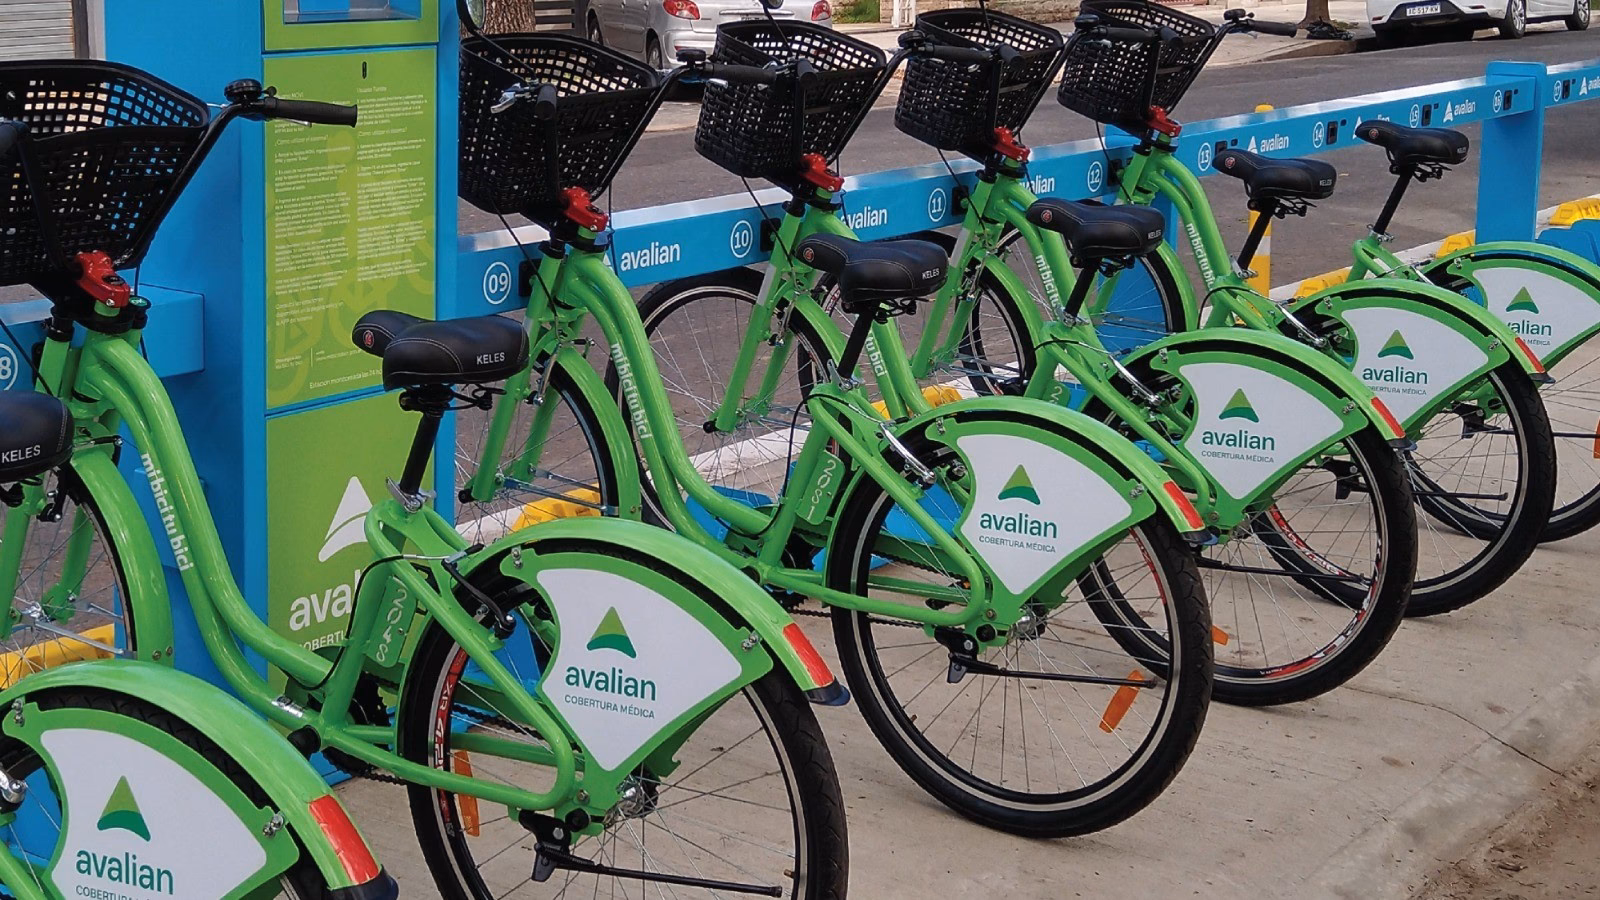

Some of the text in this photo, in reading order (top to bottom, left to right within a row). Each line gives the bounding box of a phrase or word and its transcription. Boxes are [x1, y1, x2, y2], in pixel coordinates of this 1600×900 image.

[1454, 100, 1476, 116] avalian
[1260, 134, 1290, 152] avalian
[1314, 130, 1322, 141] 14
[1200, 150, 1209, 160] 13
[1090, 169, 1100, 184] 12
[932, 196, 942, 214] 11
[734, 231, 748, 249] 10
[620, 241, 681, 272] avalian
[488, 273, 508, 293] 09
[922, 268, 940, 280] KELES
[476, 352, 505, 365] KELES
[870, 351, 887, 376] bici
[1362, 366, 1428, 384] avalian
[611, 343, 652, 438] mi bici tu bici
[1202, 430, 1275, 450] avalian
[2, 445, 41, 463] KELES
[1202, 450, 1274, 463] COBERTURA MÉDICA
[140, 452, 194, 572] mi bici tu bici
[980, 512, 1058, 538] avalian
[978, 536, 1056, 553] COBERTURA MÉDICA
[565, 666, 656, 701] avalian
[564, 694, 655, 719] COBERTURA MÉDICA
[76, 850, 174, 895] avalian
